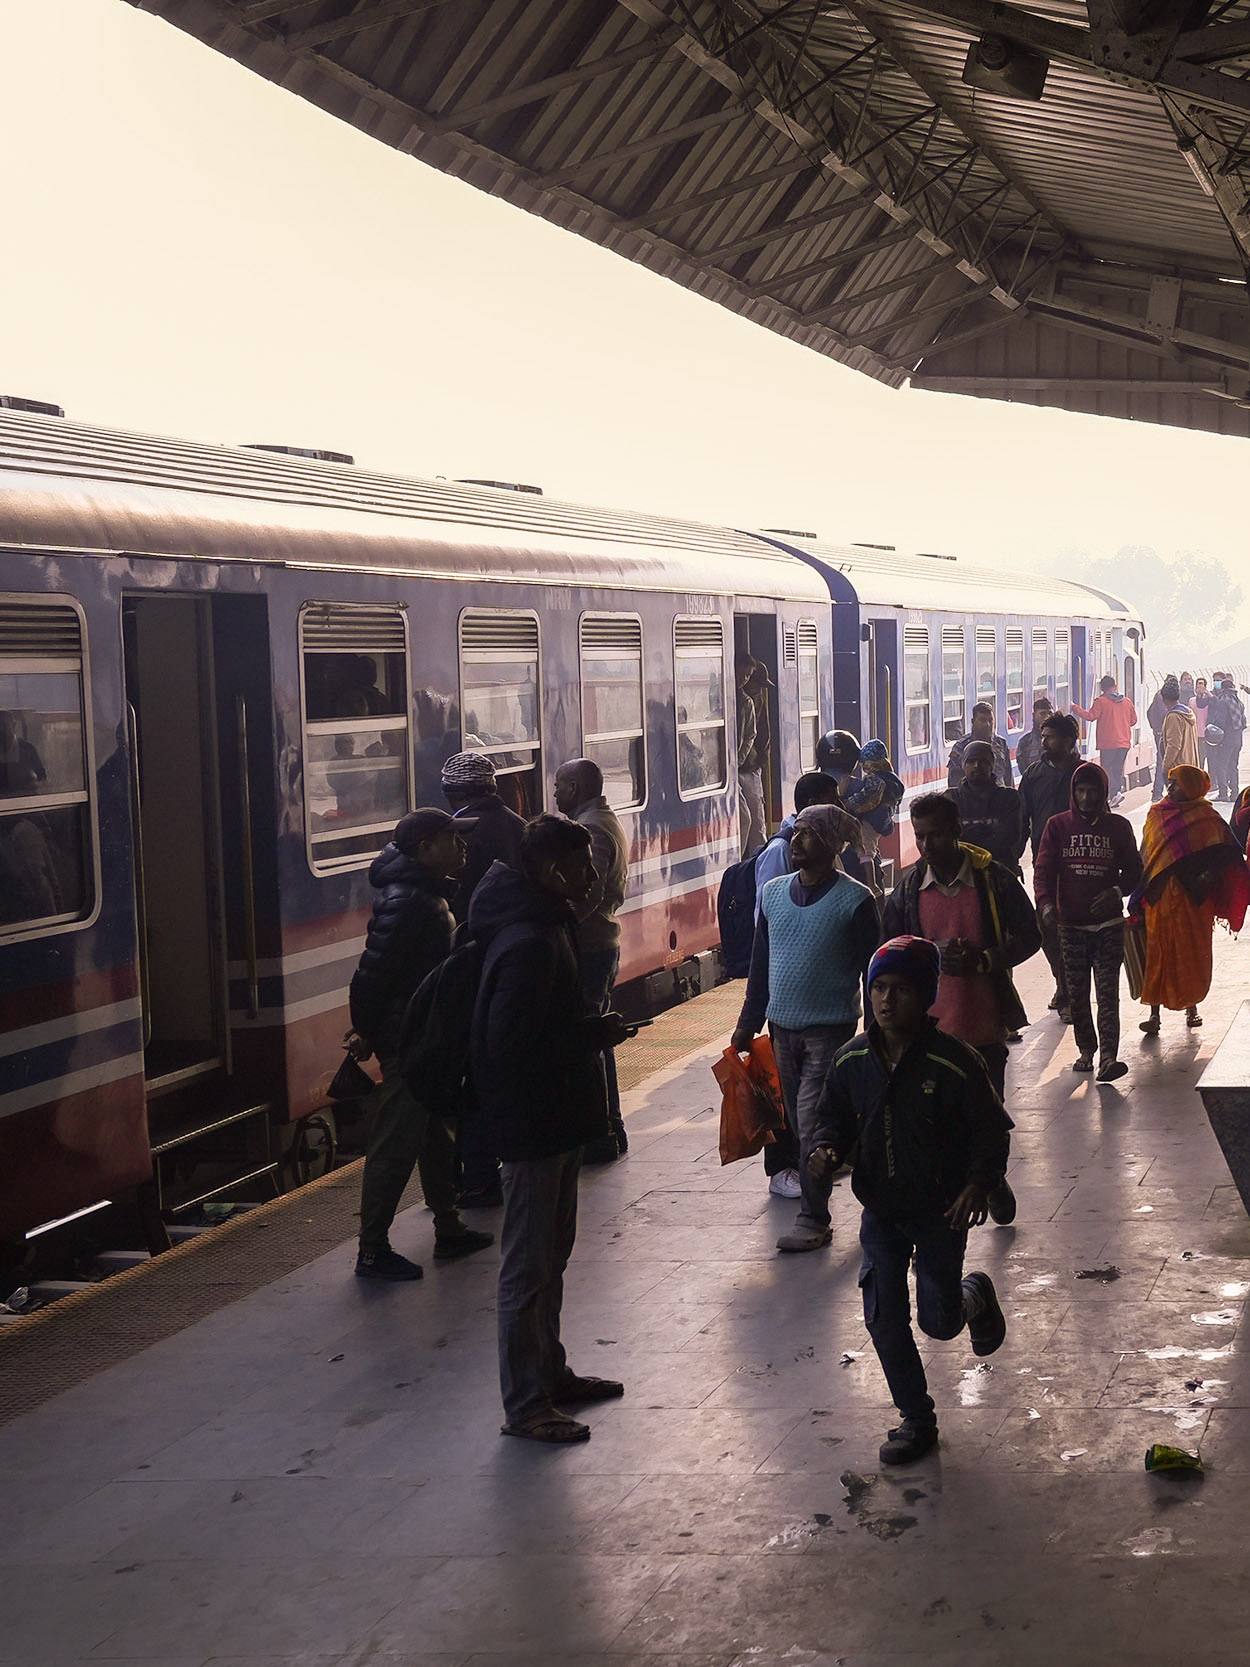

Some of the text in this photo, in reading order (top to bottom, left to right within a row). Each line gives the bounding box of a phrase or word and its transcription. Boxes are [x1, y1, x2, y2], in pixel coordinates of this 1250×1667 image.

[1071, 834, 1110, 848] FITCH
[1063, 847, 1113, 858] BOAT HOUS
